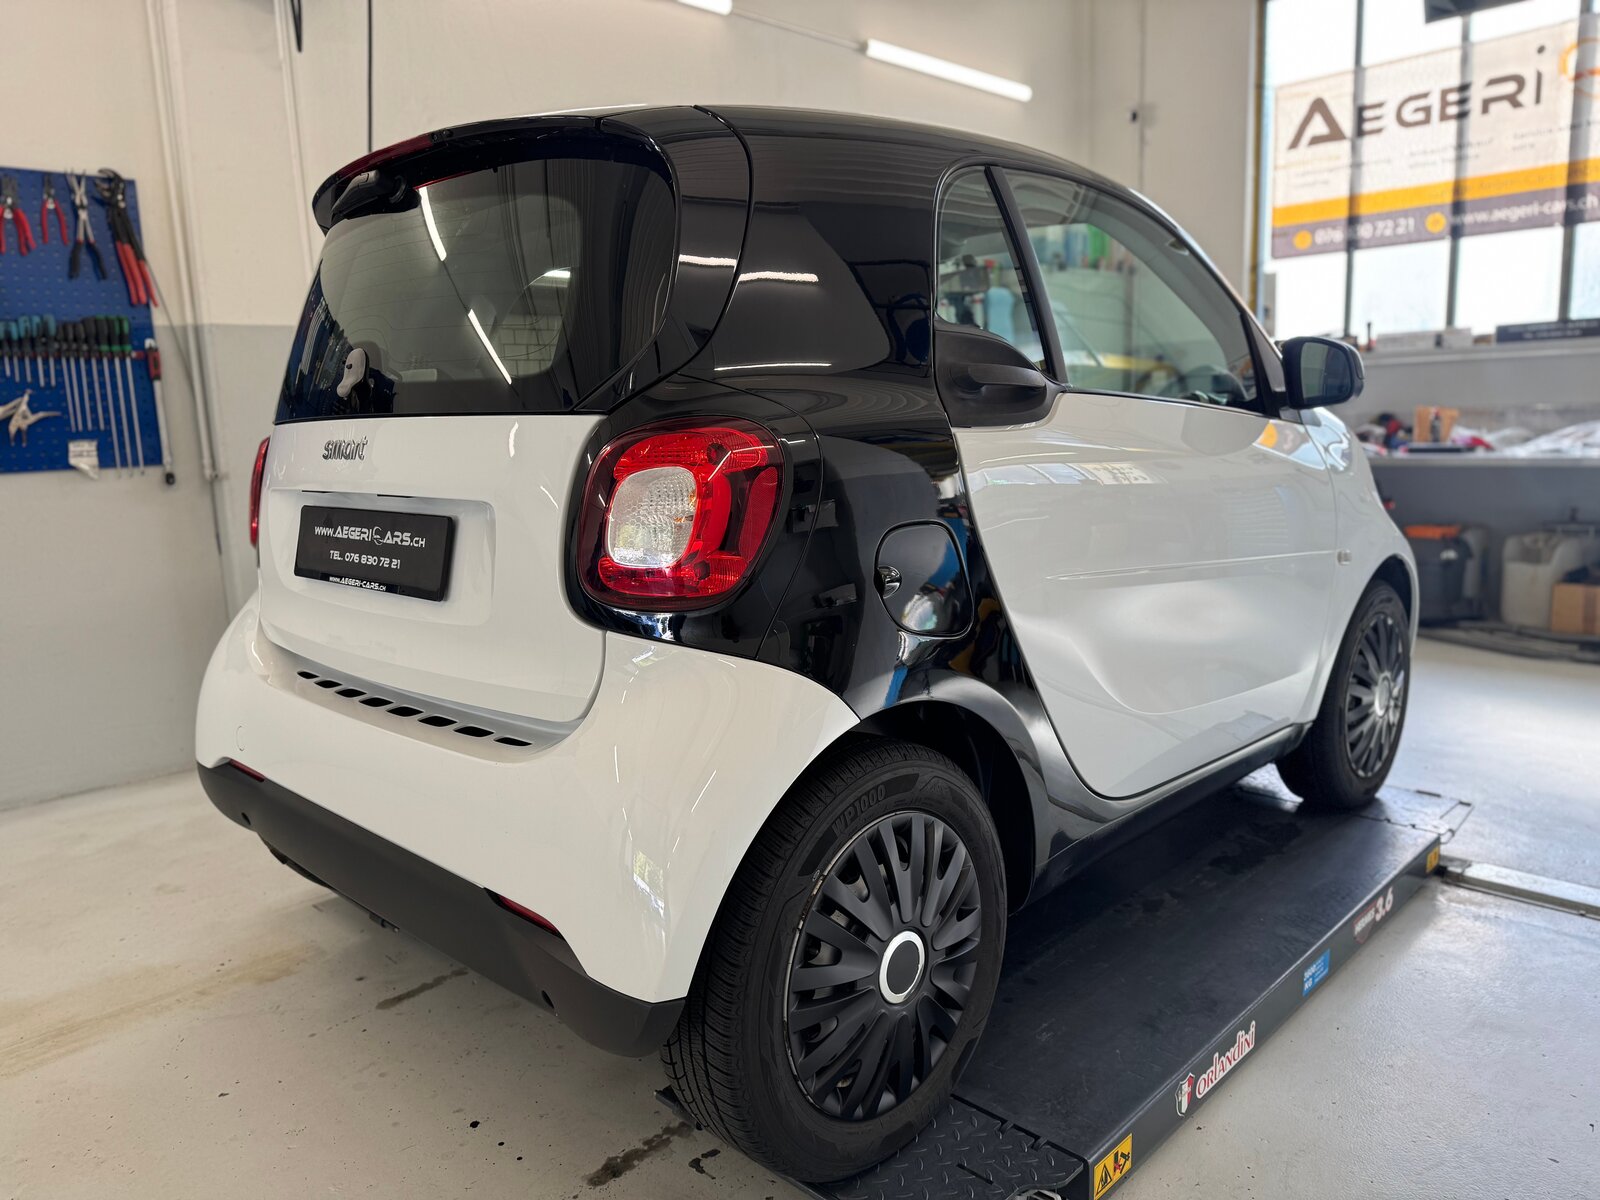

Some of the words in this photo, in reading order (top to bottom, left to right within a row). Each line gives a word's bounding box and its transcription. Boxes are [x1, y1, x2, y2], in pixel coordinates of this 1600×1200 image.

[1374, 219, 1394, 238] 72
[1395, 216, 1415, 236] 21
[322, 436, 368, 461] smart
[329, 550, 343, 561] TEL.
[344, 552, 360, 563] 076
[360, 554, 378, 566] 830
[379, 557, 390, 568] 72
[390, 558, 401, 570] 21
